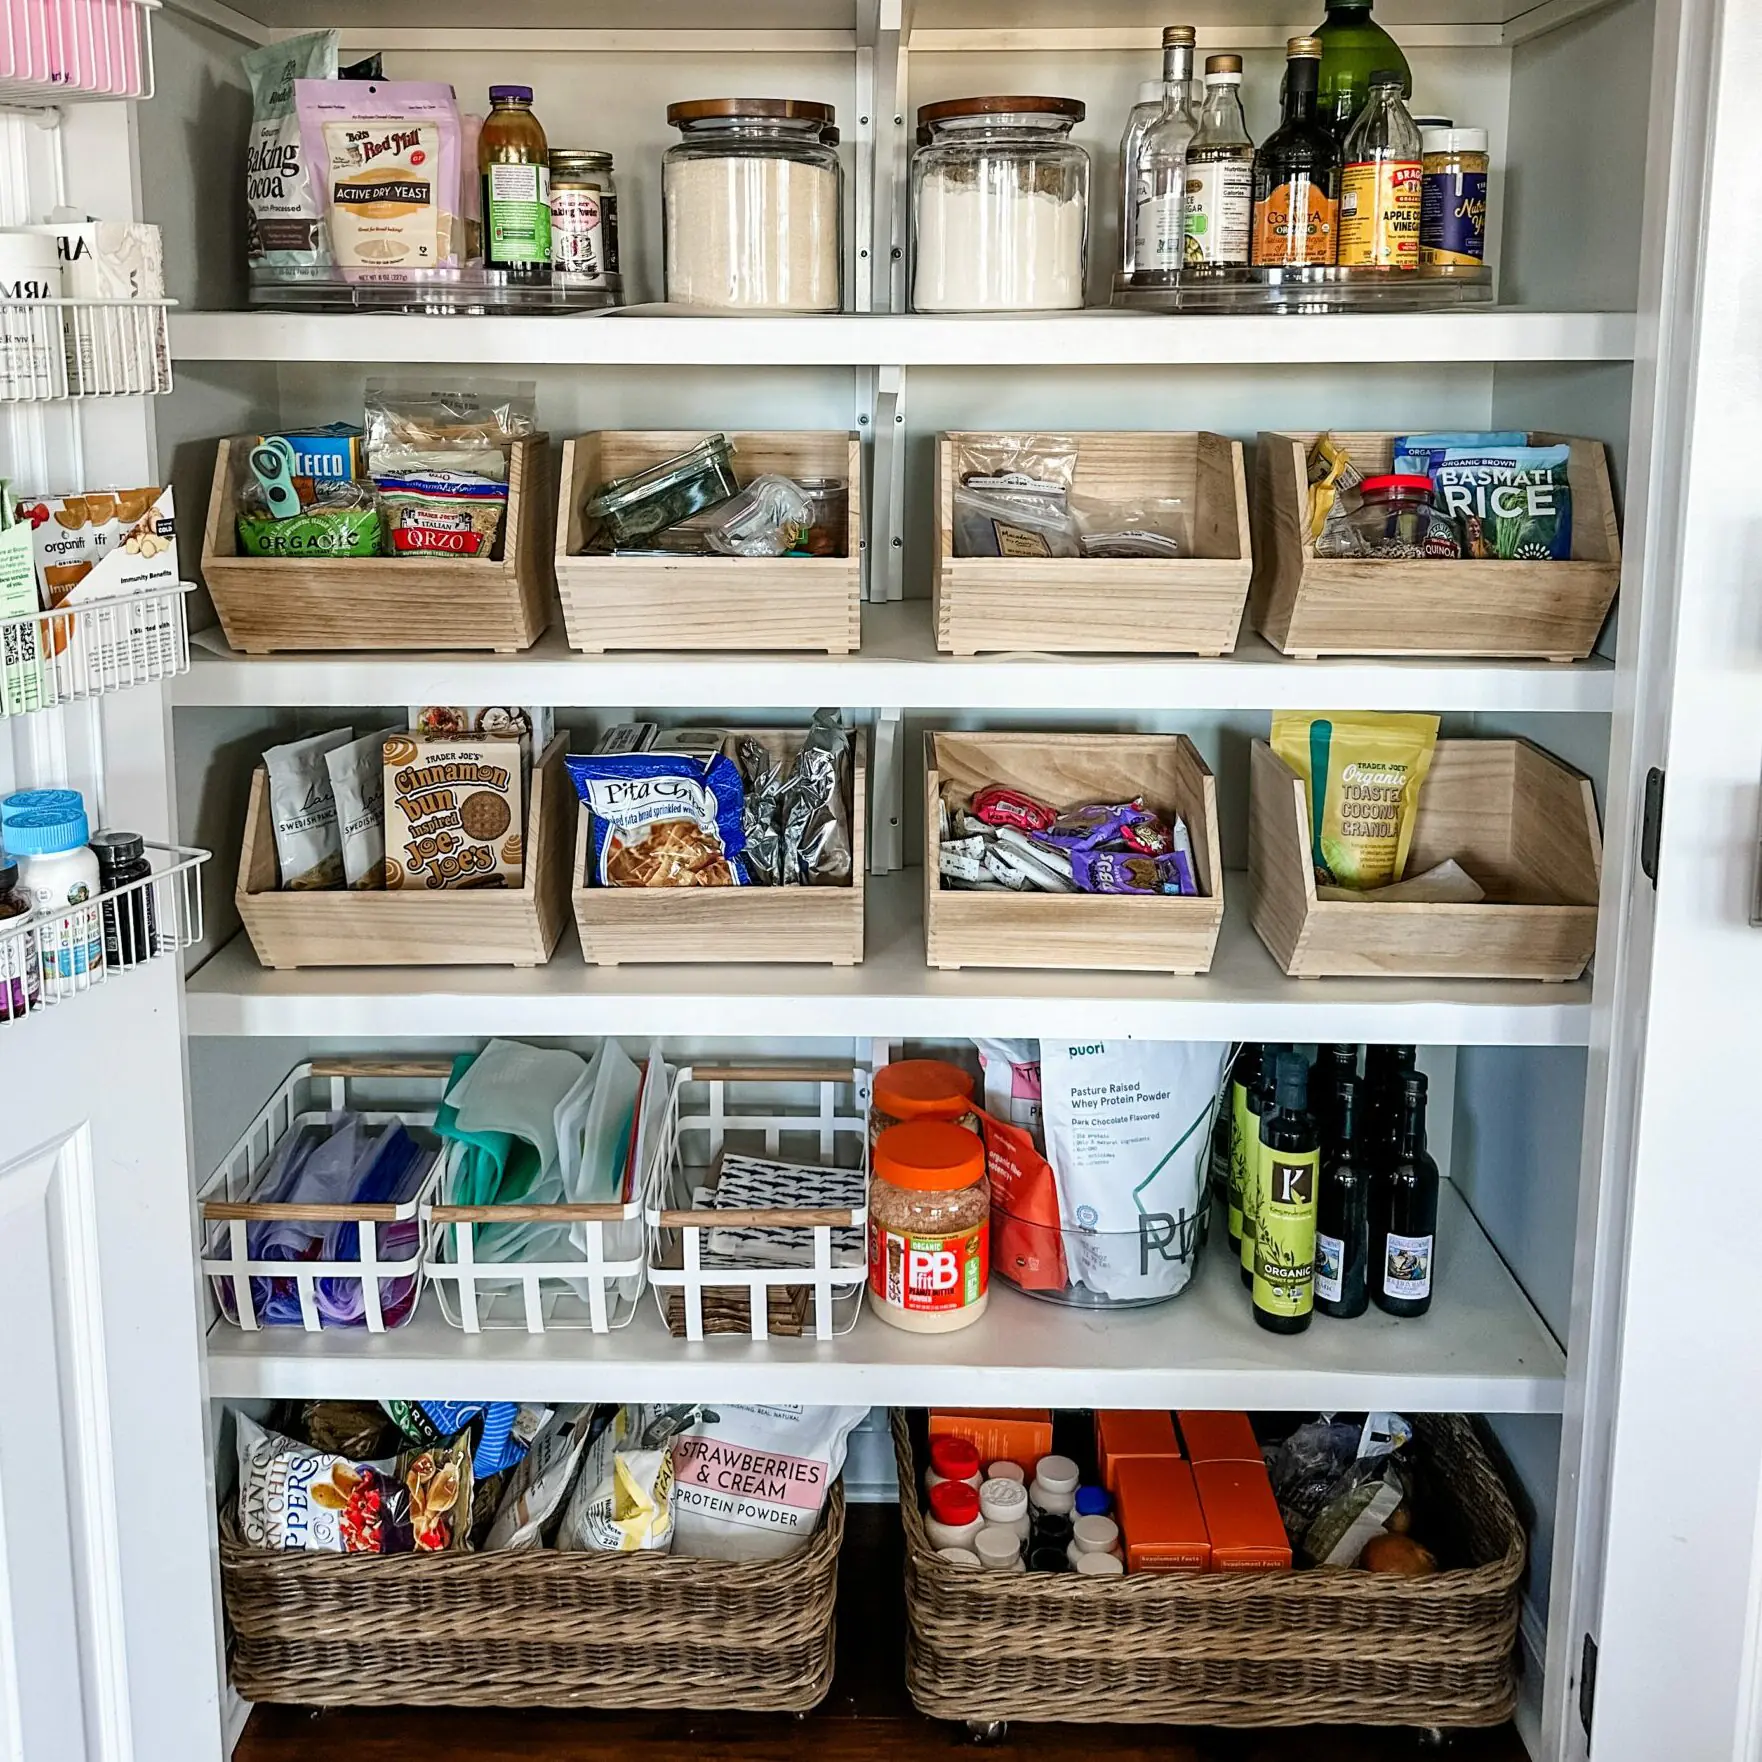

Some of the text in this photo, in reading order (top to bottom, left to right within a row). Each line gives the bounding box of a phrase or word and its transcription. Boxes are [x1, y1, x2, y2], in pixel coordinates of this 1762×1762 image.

[362, 135, 392, 164] Red
[391, 128, 421, 156] Mill
[336, 186, 428, 200] ACTIVE DRY YEAST
[1383, 211, 1411, 221] APPLE
[296, 452, 343, 477] CECCO
[1482, 459, 1516, 468] BROWN
[1441, 467, 1553, 486] BASMATI
[1443, 484, 1556, 519] RICE
[421, 520, 452, 530] ITALIAN
[408, 529, 464, 550] ORZO
[1425, 544, 1456, 559] QUINOA
[120, 570, 172, 584] Immunity Benefits
[425, 752, 481, 764] TRADER JOE'S
[1357, 762, 1386, 770] TRADER
[394, 762, 512, 792] Cinnamon
[1342, 764, 1407, 786] Organic
[604, 782, 651, 805] Pita
[394, 789, 460, 824] bun
[1342, 802, 1400, 820] COCONUT
[280, 817, 316, 832] SWEDISH
[345, 815, 376, 835] SWEDISH
[408, 811, 464, 840] inspired
[1340, 820, 1400, 838] GRANOLA
[424, 844, 498, 889] Joe's
[1068, 1041, 1105, 1060] puori
[1071, 1082, 1141, 1097] Pasture Raised
[1072, 1090, 1171, 1110] Whey Protein Powder
[1072, 1112, 1160, 1126] Dark Chocolate Flavored
[1281, 1168, 1306, 1204] K
[912, 1241, 942, 1251] ORGANIC
[909, 1250, 959, 1290] PB
[1264, 1264, 1312, 1278] ORGANIC
[917, 1272, 934, 1290] fit
[773, 1412, 800, 1422] NATURAL
[679, 1441, 820, 1484] STRAWBERRIES
[696, 1464, 710, 1484] &
[718, 1470, 788, 1500] CREAM
[676, 1488, 798, 1527] PROTEIN POWDER
[603, 1538, 619, 1546] 220
